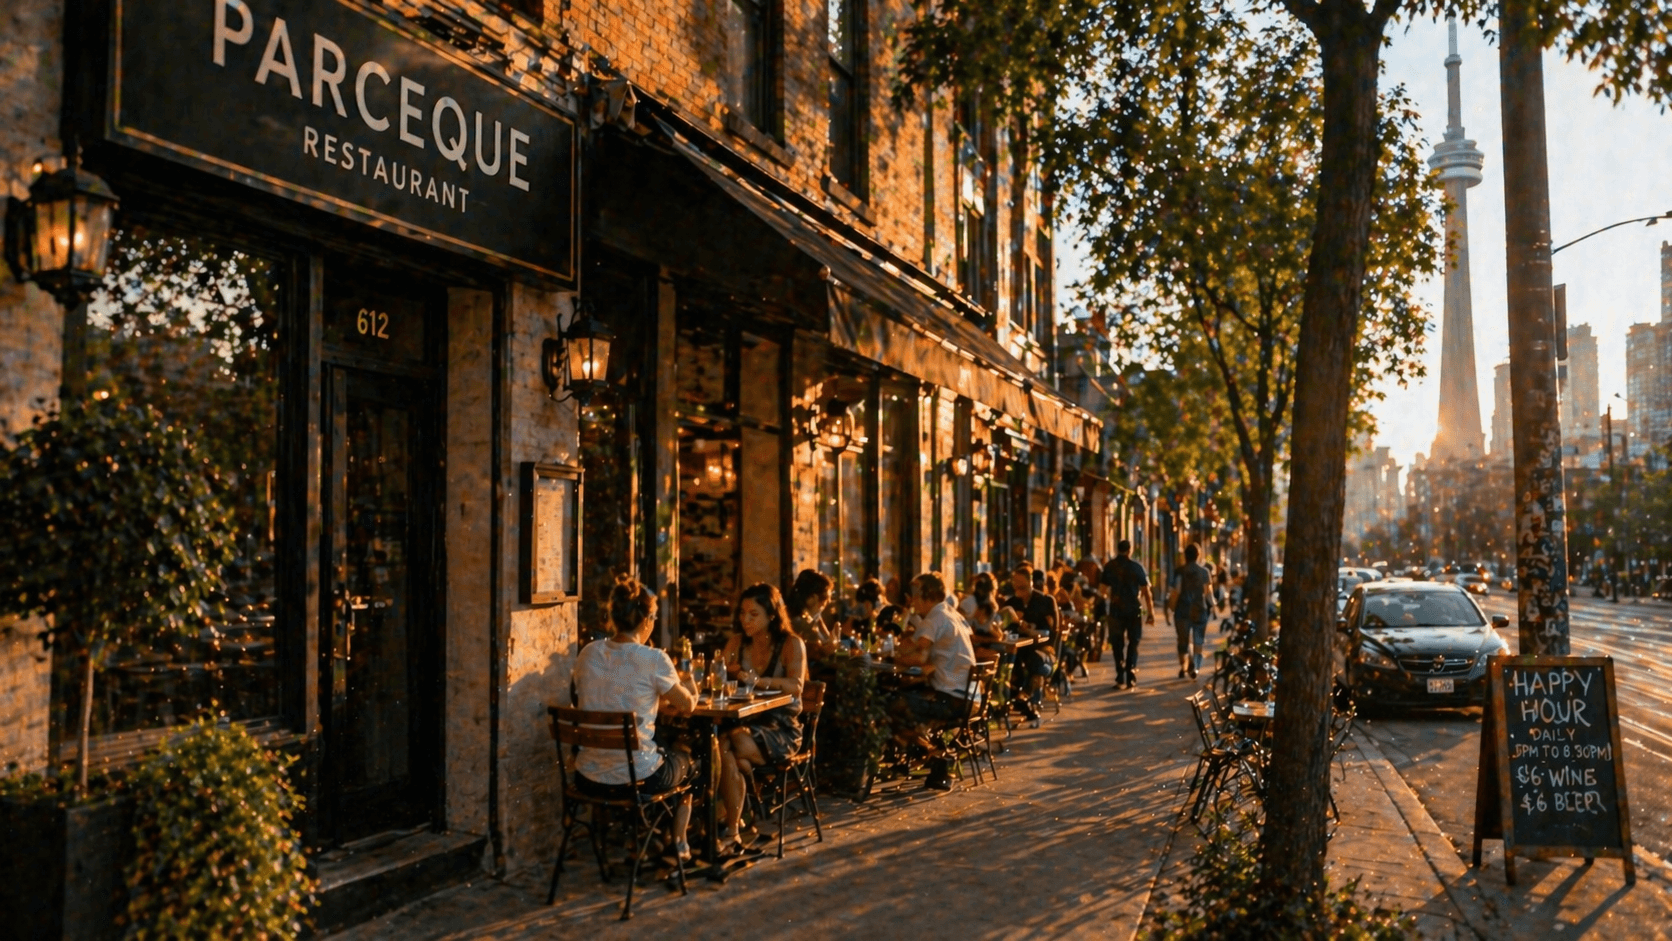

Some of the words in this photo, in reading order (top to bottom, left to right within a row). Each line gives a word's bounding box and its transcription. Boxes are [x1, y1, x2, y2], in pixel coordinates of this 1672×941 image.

[213, 0, 530, 192] PARCEQUE
[303, 125, 470, 213] RESTAURANT
[357, 308, 389, 339] 612
[1513, 669, 1592, 696] HAPPY
[1521, 698, 1591, 727] HOUR
[1530, 728, 1576, 741] DAILY
[1542, 745, 1560, 759] TO
[1548, 765, 1597, 787] WINE
[1554, 790, 1607, 815] BEER
